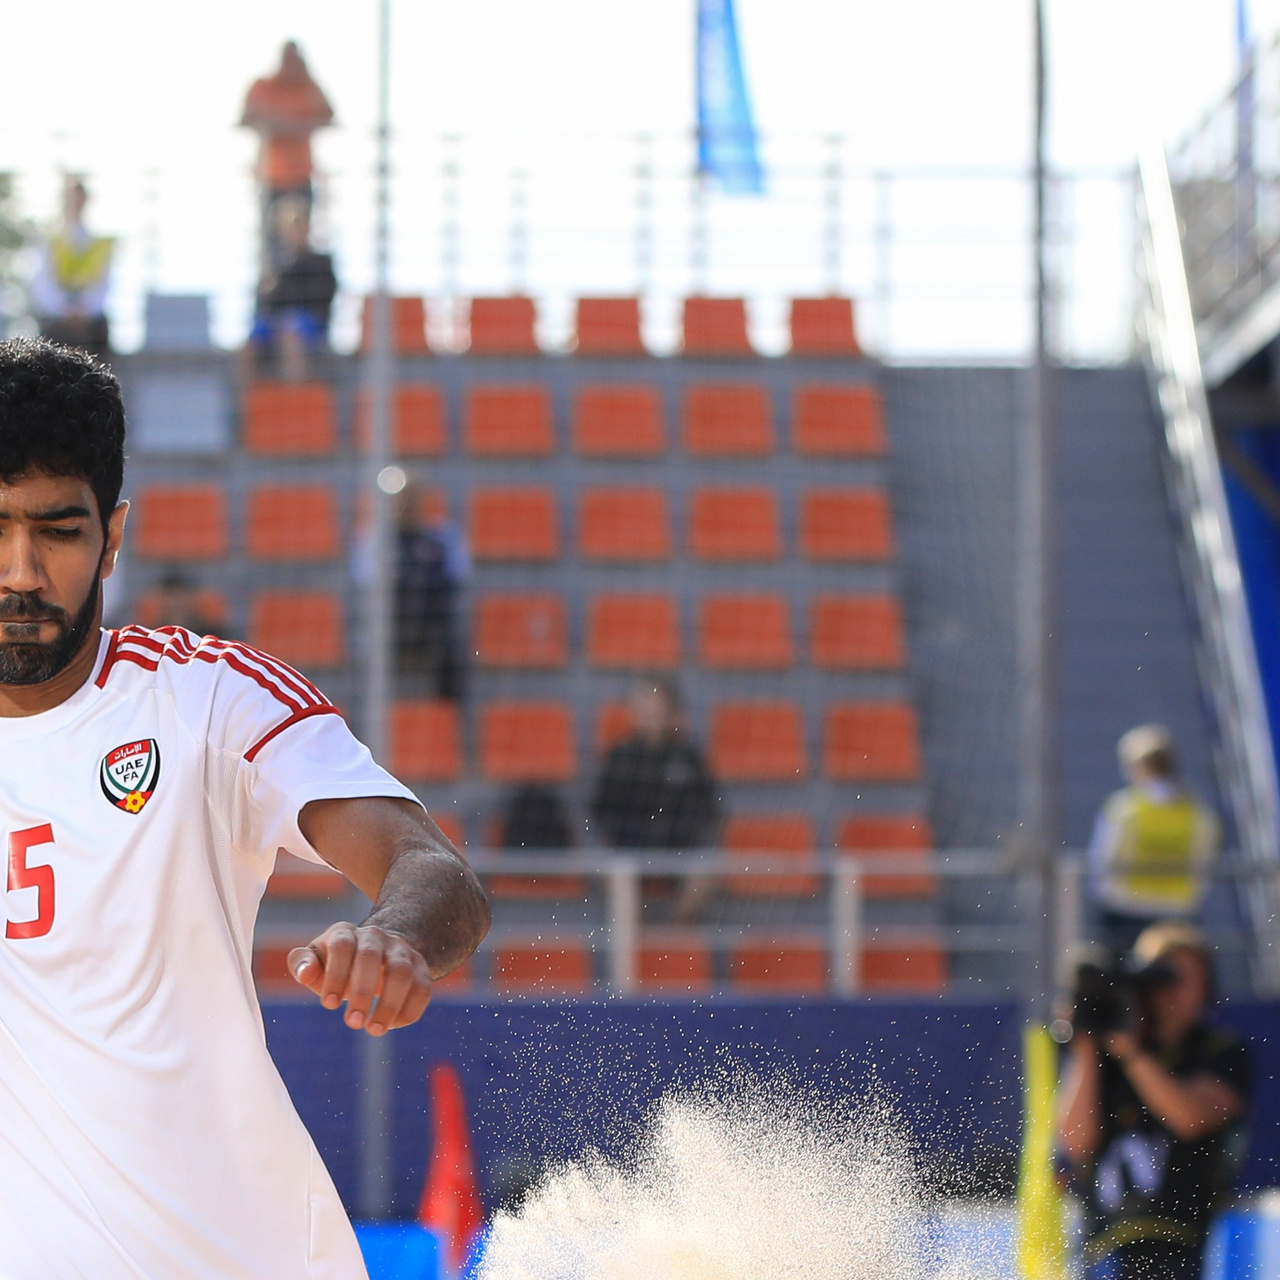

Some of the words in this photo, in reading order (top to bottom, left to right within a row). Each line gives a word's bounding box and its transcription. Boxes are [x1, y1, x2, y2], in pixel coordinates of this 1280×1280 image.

[115, 758, 144, 775] UAE
[123, 771, 139, 783] FA
[5, 822, 56, 940] 5
